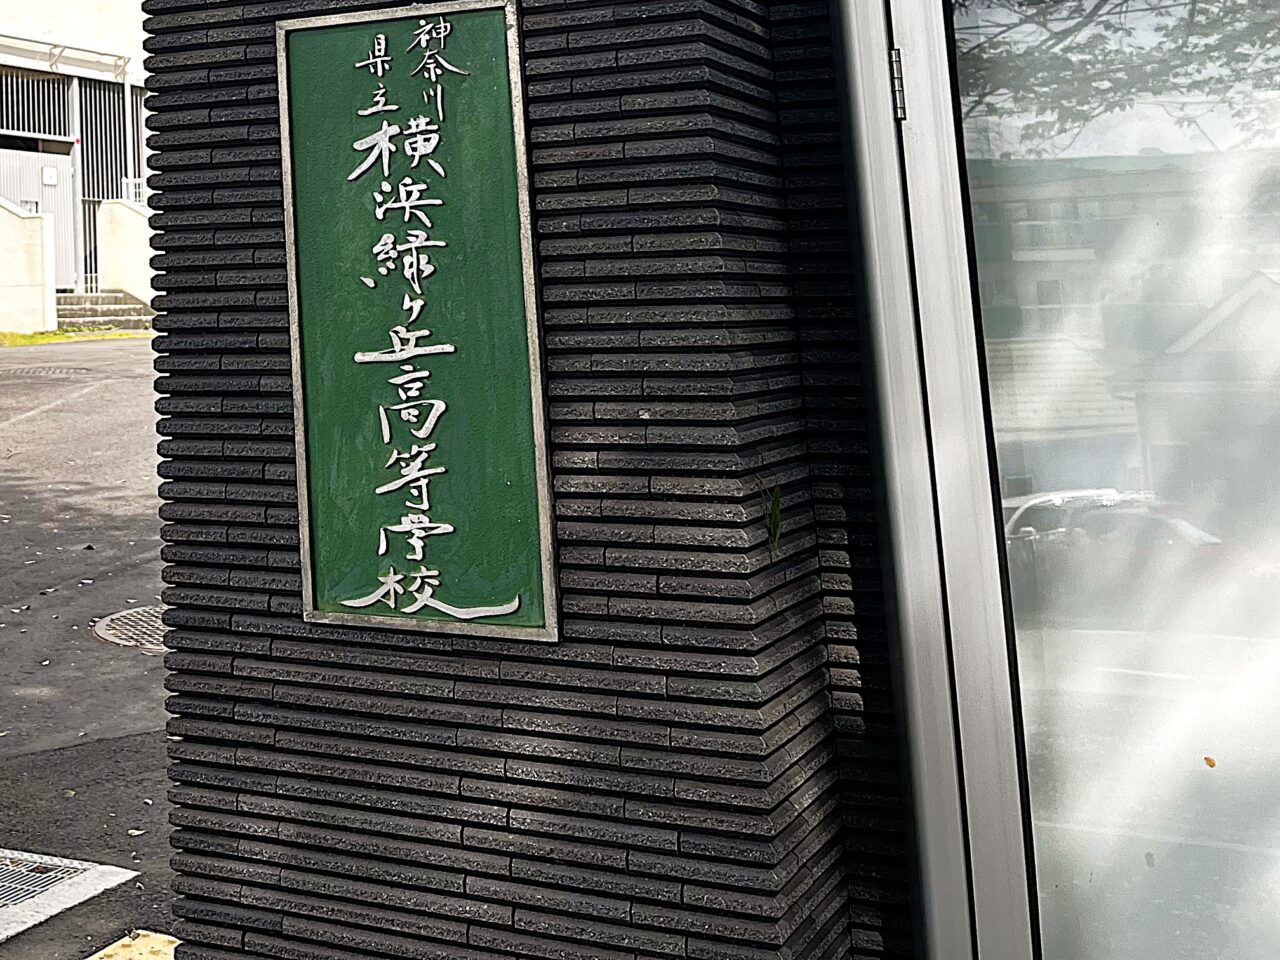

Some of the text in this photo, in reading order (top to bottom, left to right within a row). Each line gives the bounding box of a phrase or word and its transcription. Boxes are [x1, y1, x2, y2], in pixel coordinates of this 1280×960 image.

[354, 33, 400, 116] 県立
[406, 15, 470, 122] 神奈川
